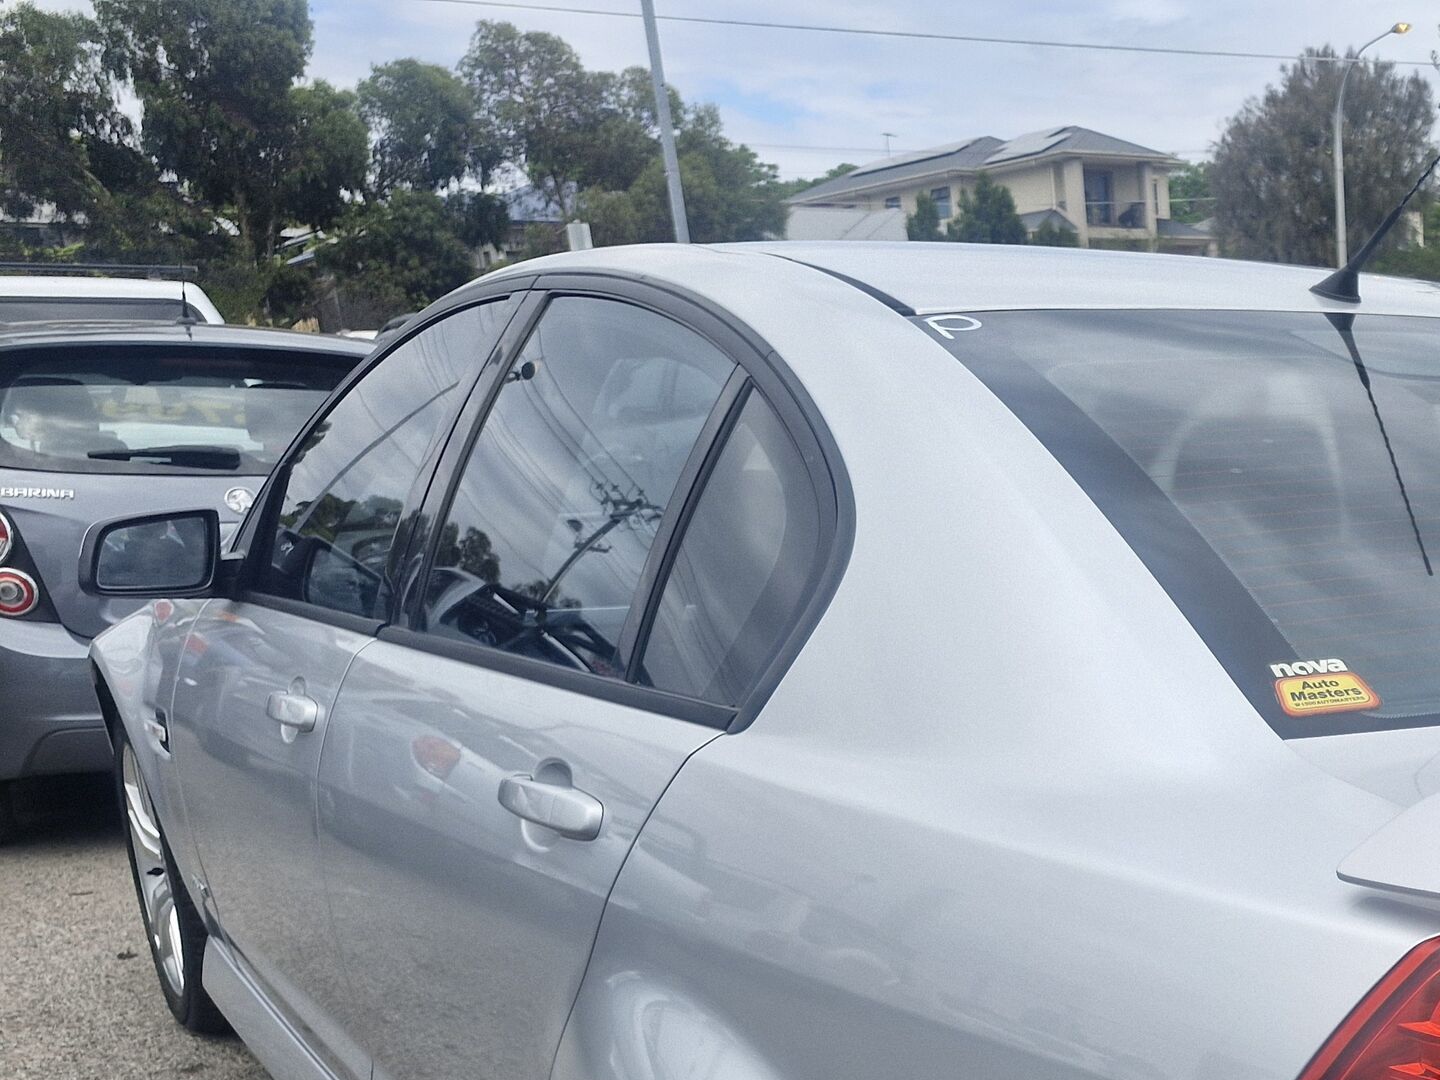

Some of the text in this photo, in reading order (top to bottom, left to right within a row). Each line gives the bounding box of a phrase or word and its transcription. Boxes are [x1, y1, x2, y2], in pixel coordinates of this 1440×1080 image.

[0, 487, 76, 500] BARINA
[1270, 658, 1348, 678] nova
[1301, 679, 1340, 691] Auto
[1290, 687, 1362, 702] Masters
